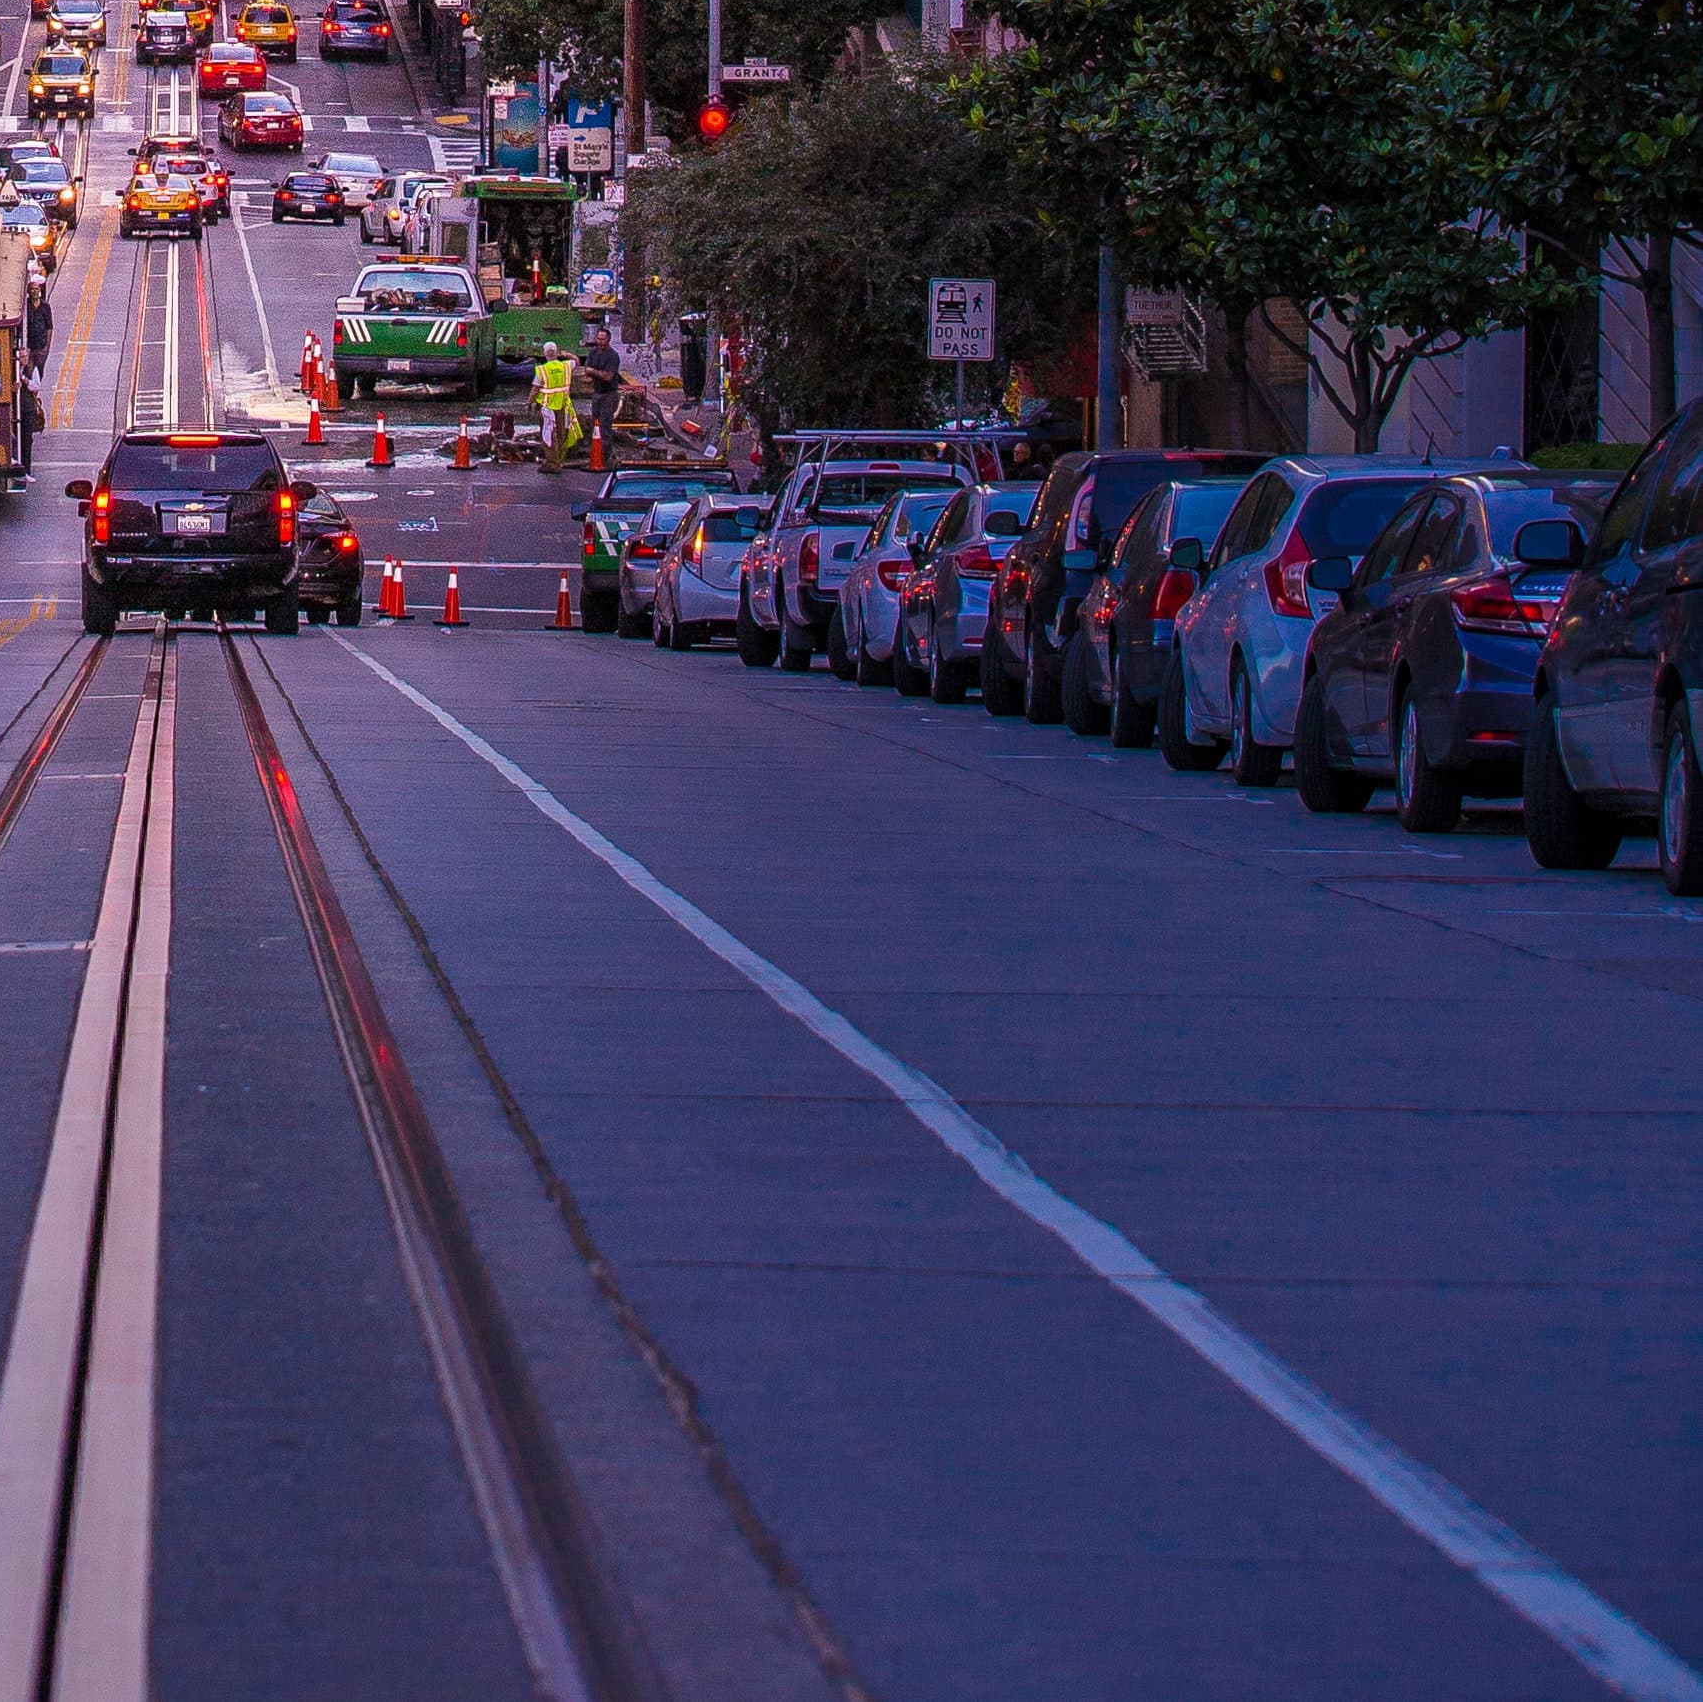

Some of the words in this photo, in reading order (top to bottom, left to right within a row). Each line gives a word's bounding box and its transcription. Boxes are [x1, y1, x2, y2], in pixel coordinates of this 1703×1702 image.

[734, 68, 777, 77] GRANT
[934, 327, 953, 340] DO
[960, 326, 988, 340] NOT
[943, 343, 979, 356] PASS
